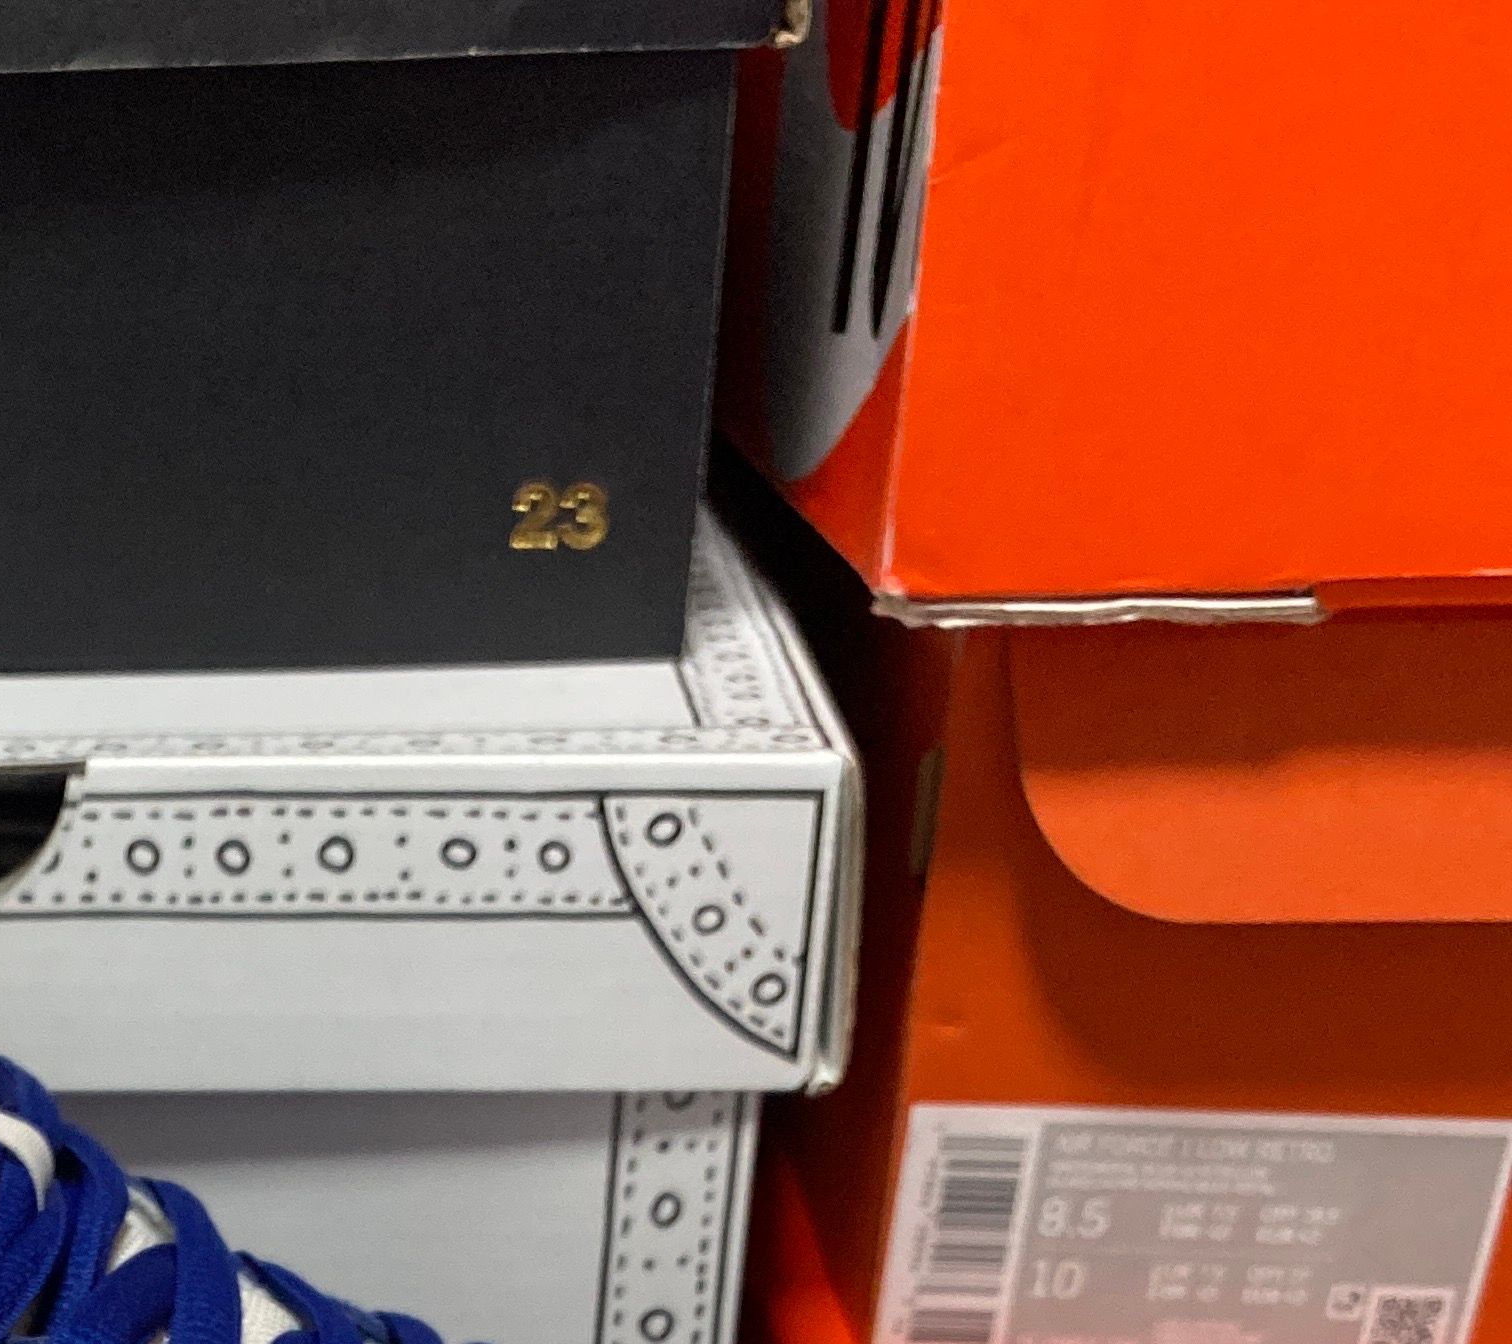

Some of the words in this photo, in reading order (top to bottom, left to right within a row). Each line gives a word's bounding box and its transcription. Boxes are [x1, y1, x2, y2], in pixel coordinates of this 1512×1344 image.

[509, 481, 610, 550] 23
[1037, 1196, 1112, 1240] 8.5
[1028, 1259, 1090, 1300] 10
